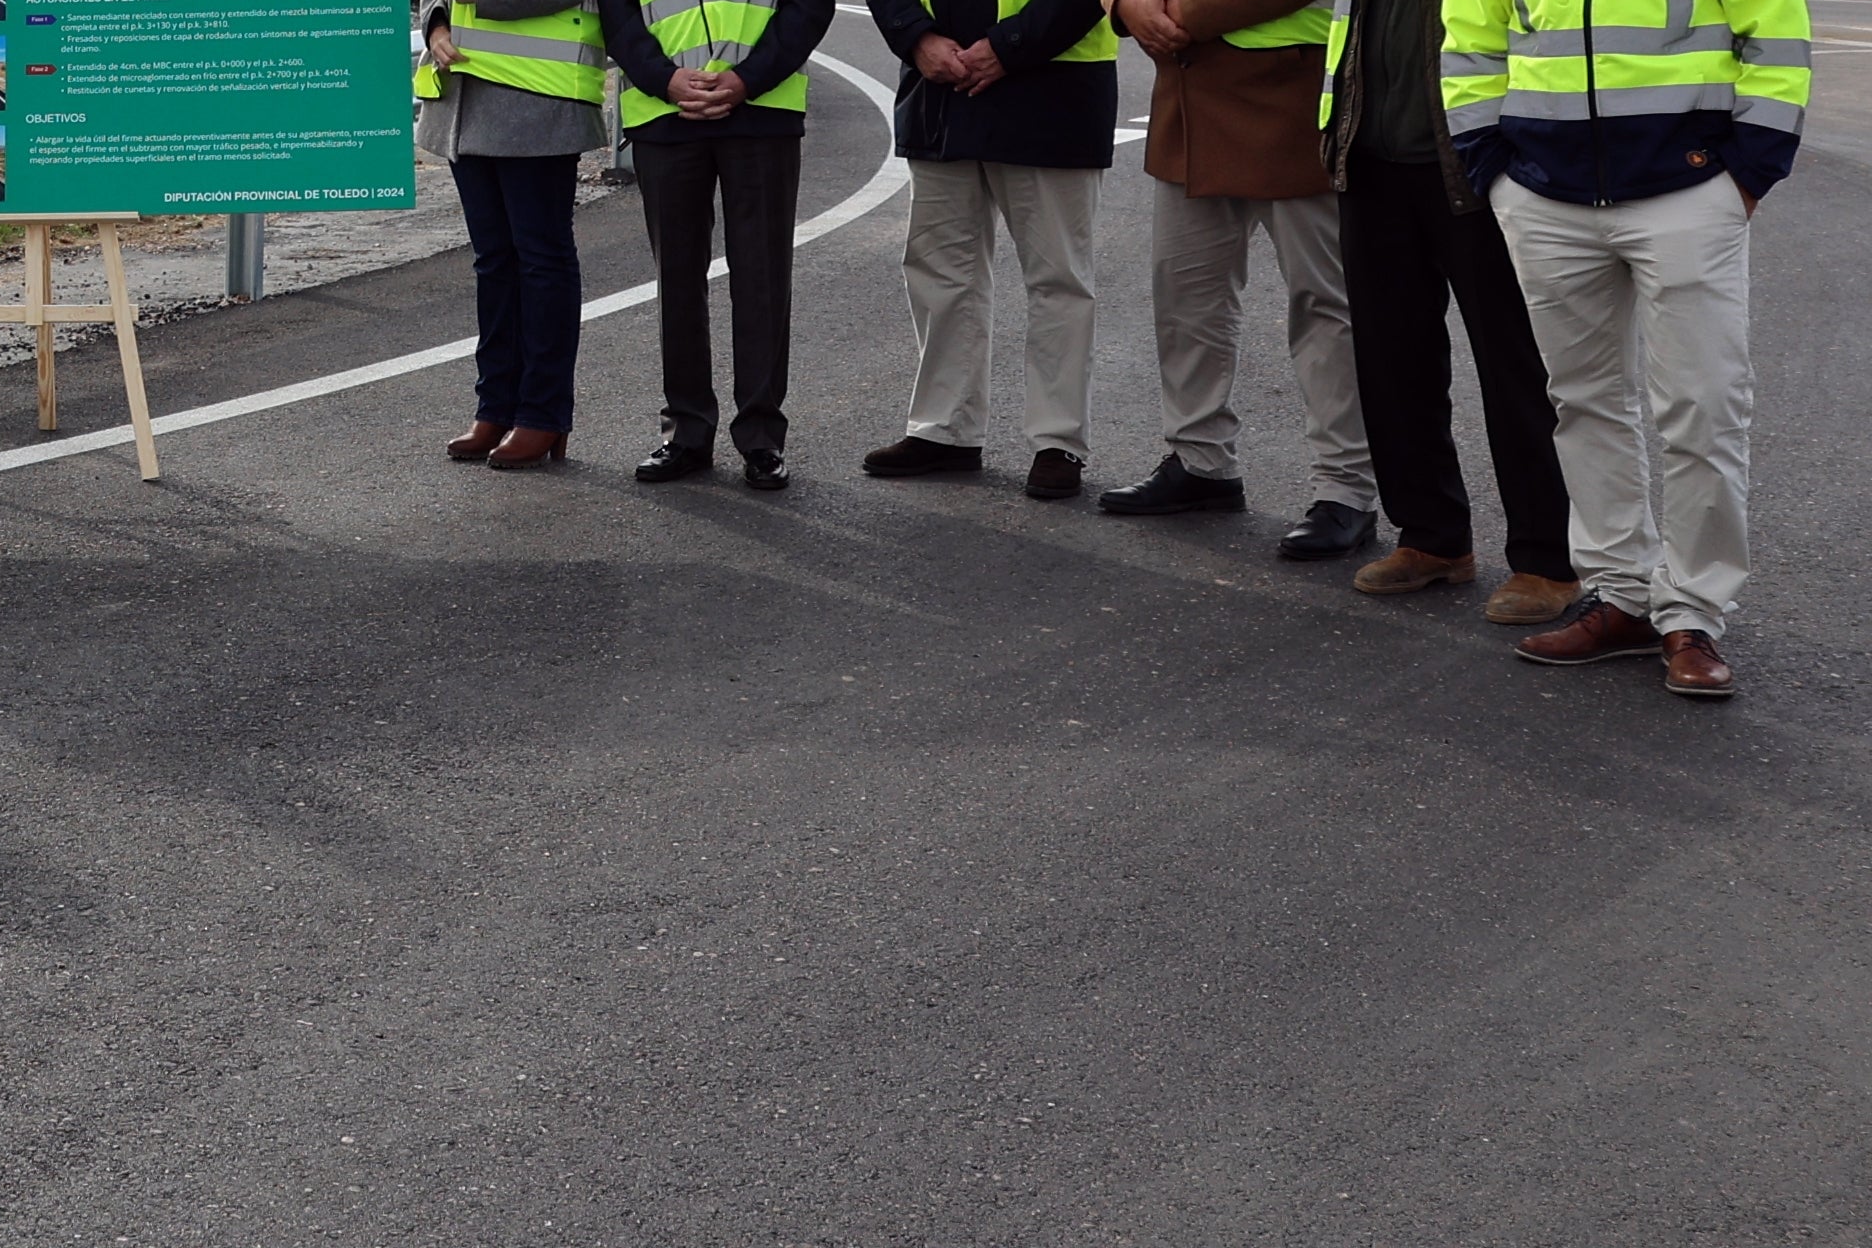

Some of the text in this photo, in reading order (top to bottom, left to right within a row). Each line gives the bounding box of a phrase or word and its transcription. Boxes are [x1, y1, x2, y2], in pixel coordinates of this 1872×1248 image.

[92, 12, 130, 20] mediante
[131, 11, 167, 19] reciclado
[184, 10, 220, 18] cemento
[226, 8, 267, 17] extendido
[280, 7, 308, 15] mezcla
[309, 6, 354, 15] bituminosa
[362, 5, 392, 13] sección
[60, 23, 97, 33] completa
[66, 34, 102, 42] Fresados
[110, 33, 160, 43] reposiciones
[172, 34, 192, 42] capa
[205, 31, 242, 39] rodadura
[310, 28, 360, 38] agotamiento
[373, 27, 394, 35] resto
[66, 63, 106, 71] Extendido
[66, 86, 110, 94] Restitución
[124, 85, 155, 93] cunetas
[162, 84, 207, 92] renovación
[220, 82, 268, 91] señalización
[270, 82, 299, 90] vertical
[25, 113, 86, 123] OBJETIVOS
[35, 135, 64, 145] Alargar
[144, 133, 182, 141] actuando
[182, 131, 250, 142] preventivamente
[353, 128, 400, 136] recreciendo
[164, 190, 232, 202] DIPUTACIÓN
[234, 190, 302, 201] PROVINCIAL
[304, 189, 319, 199] DE
[323, 188, 368, 199] TOLEDO
[376, 187, 404, 197] 2024
